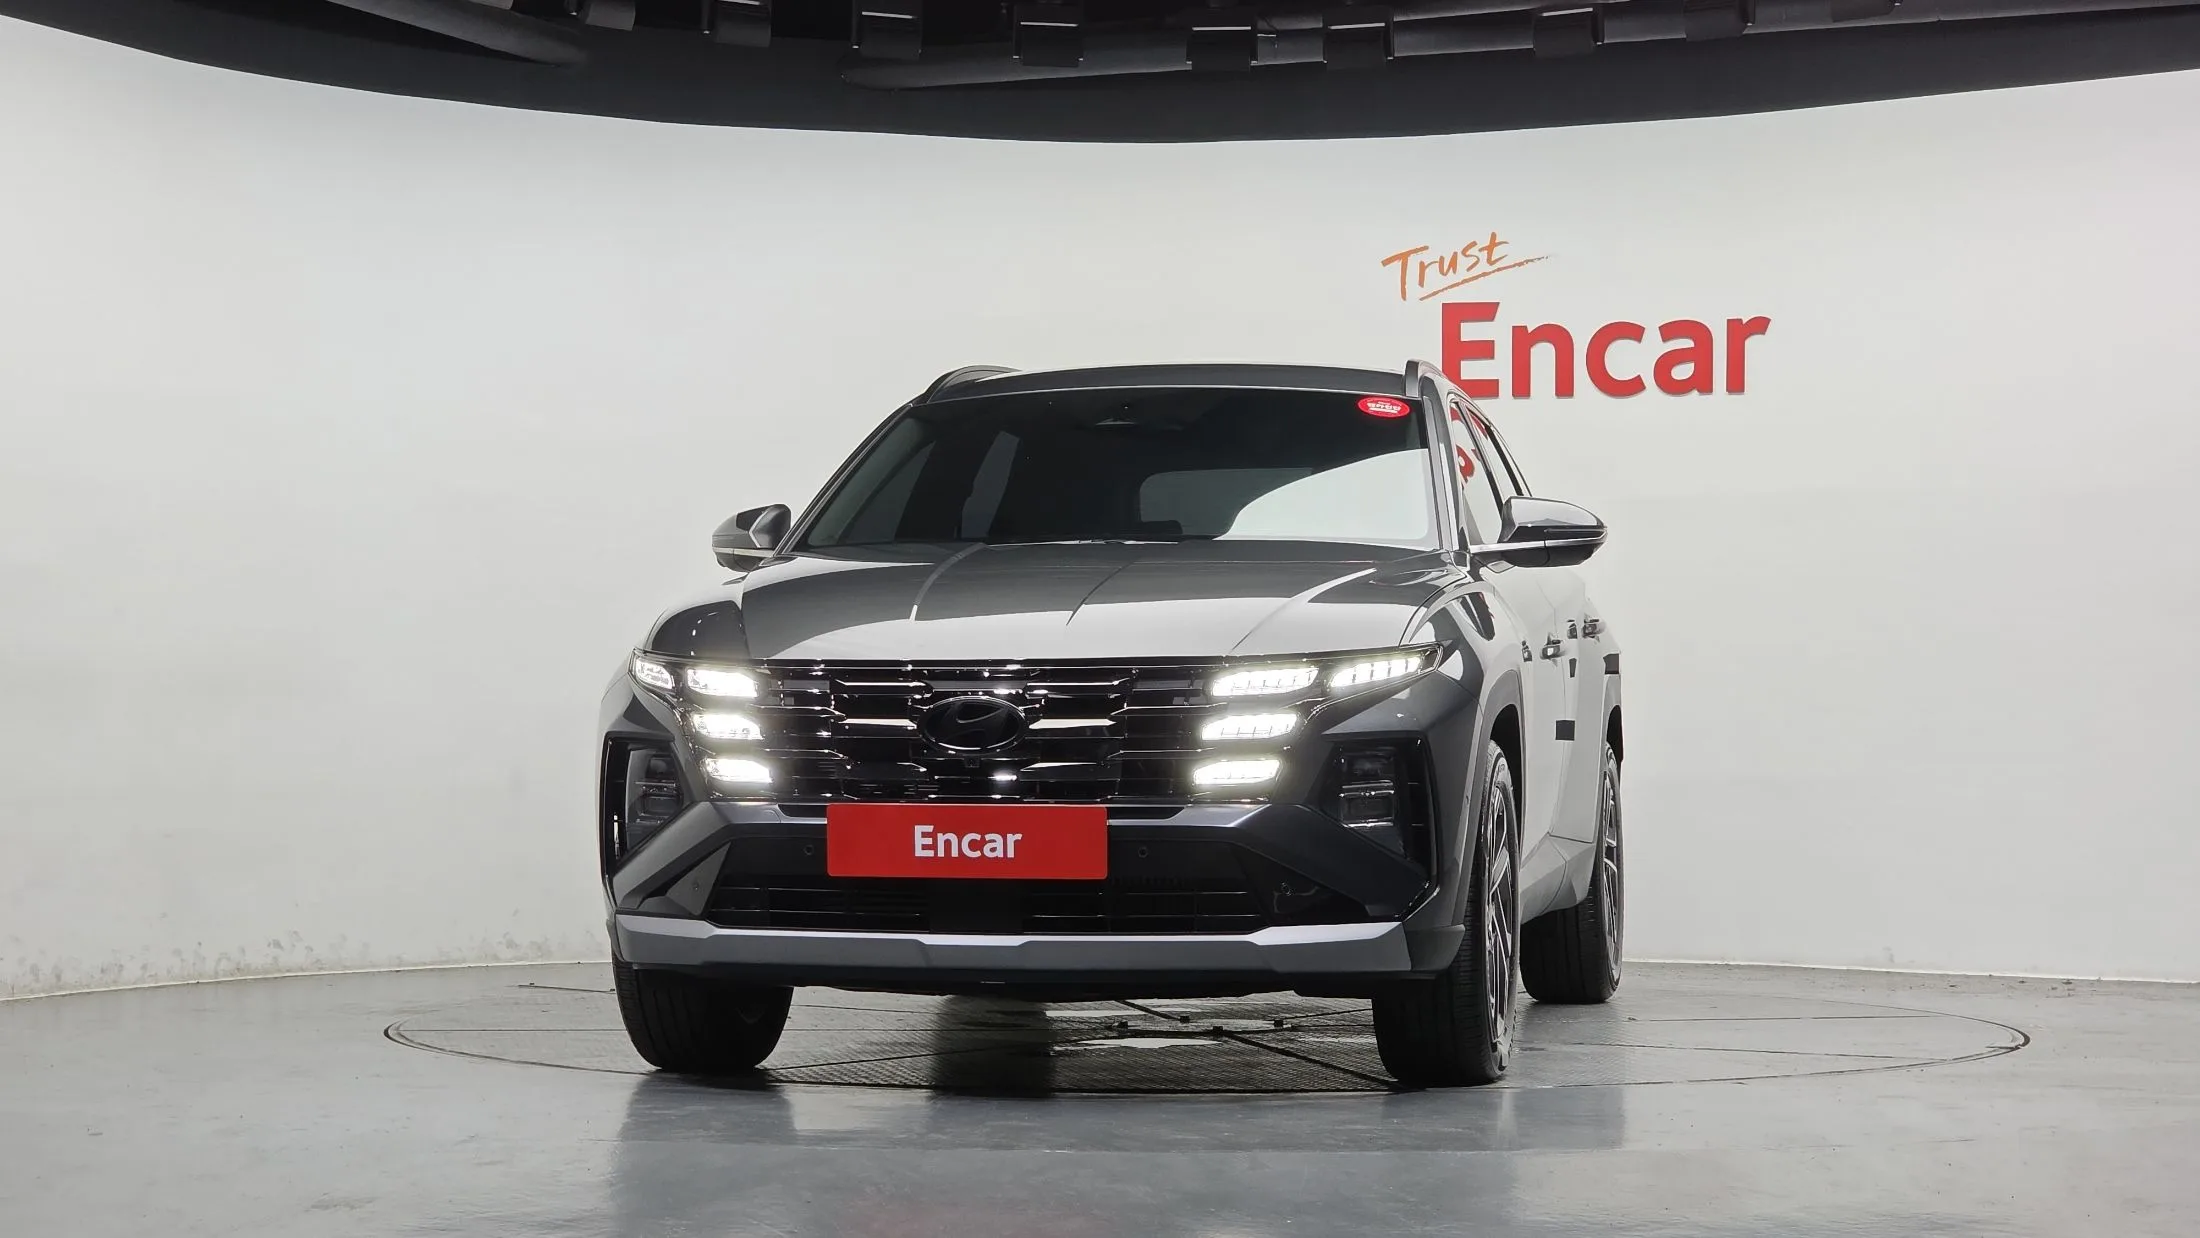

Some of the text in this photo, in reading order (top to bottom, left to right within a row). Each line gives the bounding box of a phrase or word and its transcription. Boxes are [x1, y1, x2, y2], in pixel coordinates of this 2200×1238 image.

[1381, 231, 1510, 301] Trust
[1441, 301, 1772, 400] Encar
[914, 825, 1022, 858] Encar
